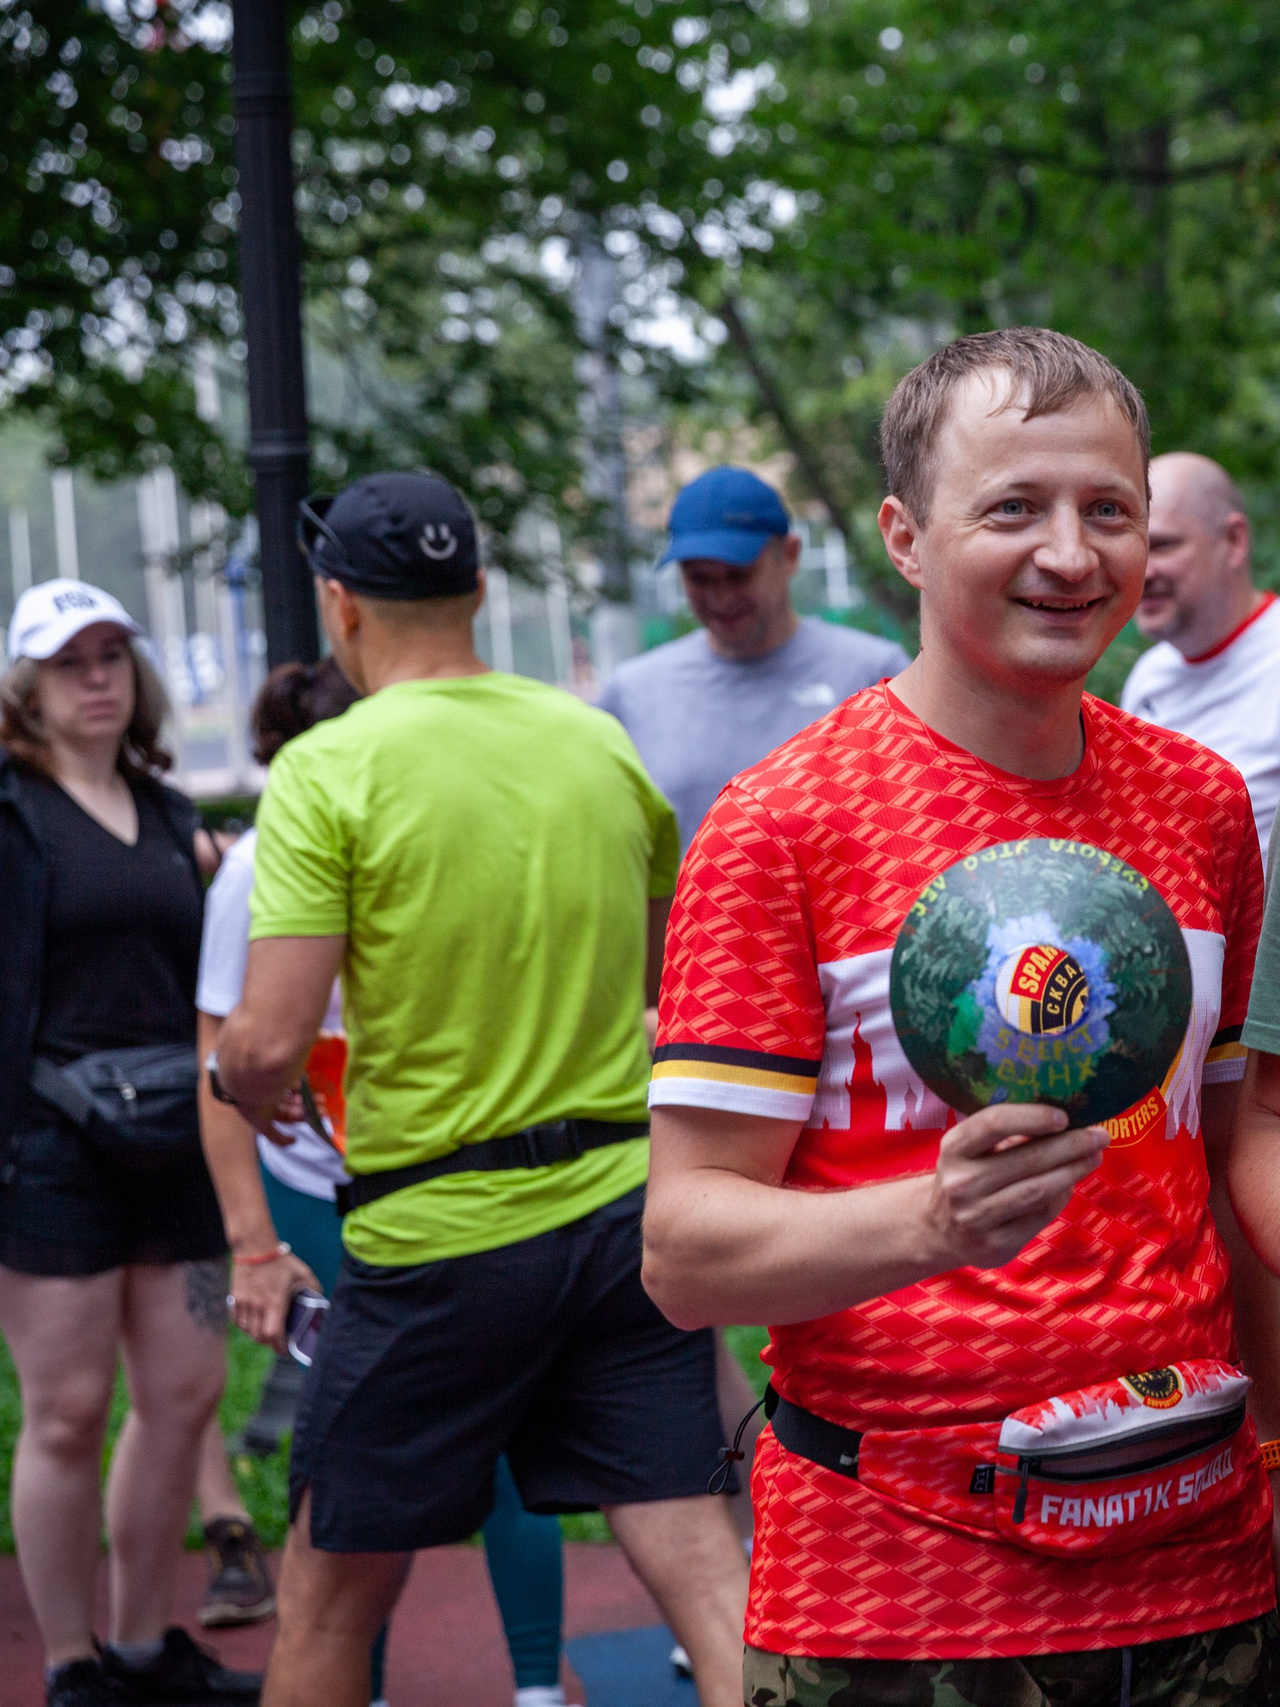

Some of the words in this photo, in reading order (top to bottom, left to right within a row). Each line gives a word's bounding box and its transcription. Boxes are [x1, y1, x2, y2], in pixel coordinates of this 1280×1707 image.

[1046, 963, 1083, 1016] СКВА
[995, 1027, 1015, 1050] 5
[997, 1055, 1097, 1091] ВДНХ
[1096, 1095, 1160, 1140] ORTERS
[1178, 1446, 1234, 1507] SQUAD
